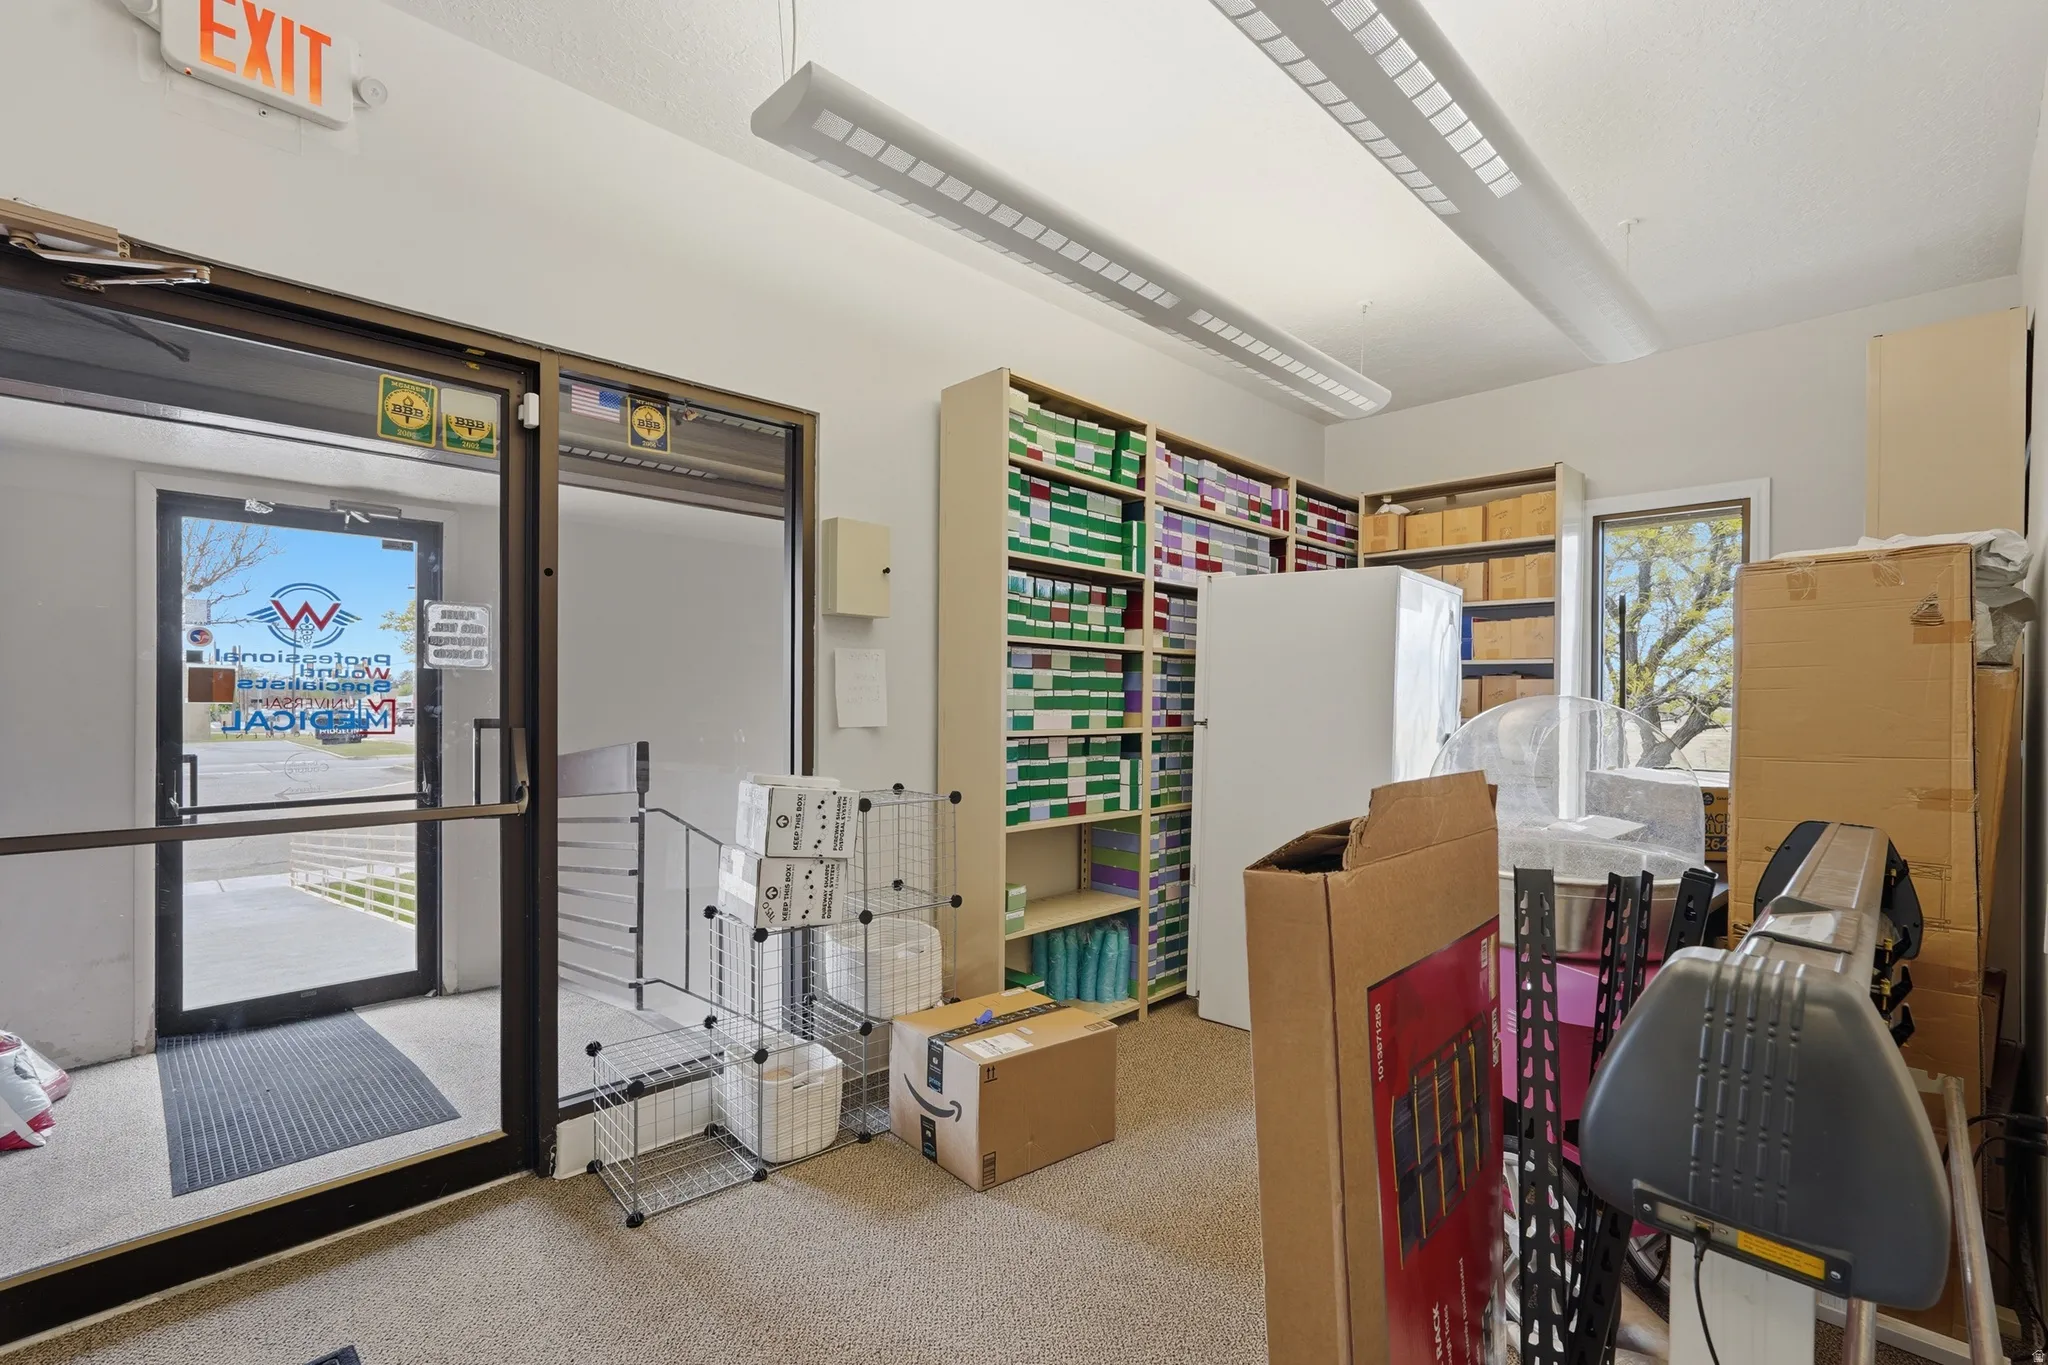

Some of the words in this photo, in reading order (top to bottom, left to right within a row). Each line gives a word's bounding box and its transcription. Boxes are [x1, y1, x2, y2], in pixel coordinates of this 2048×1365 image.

[199, 0, 332, 107] EXIT
[391, 403, 425, 418] BBB
[454, 416, 485, 429] BBB
[636, 419, 661, 430] BBB
[796, 793, 804, 812] BOX!
[835, 796, 843, 820] SHARPS
[794, 813, 802, 830] THIS
[832, 821, 840, 851] PUREWAY
[838, 822, 846, 852] DISPOSAL
[826, 889, 834, 919] DISPOSAL
[1459, 1257, 1468, 1320] Distributed
[1432, 1301, 1443, 1361] RACK
